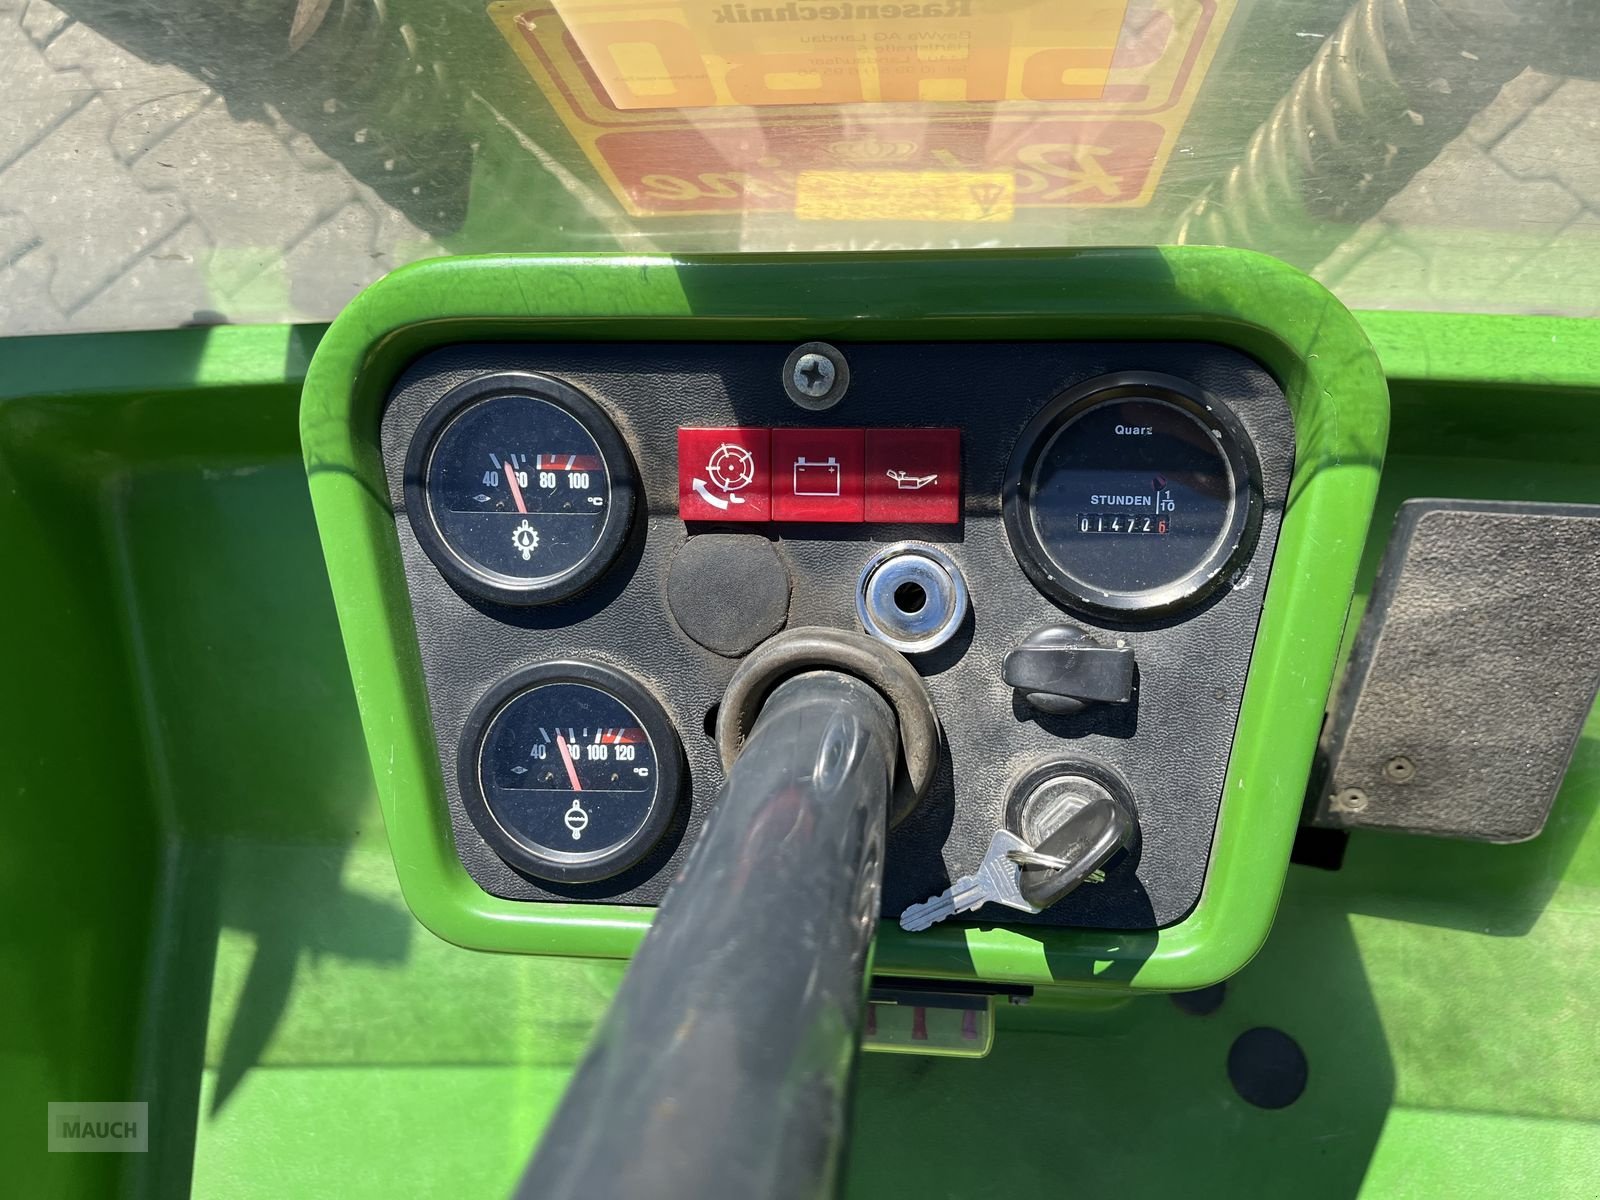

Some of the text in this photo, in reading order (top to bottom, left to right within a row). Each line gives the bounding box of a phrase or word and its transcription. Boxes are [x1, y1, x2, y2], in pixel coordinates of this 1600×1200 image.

[1114, 424, 1153, 436] Quarz
[482, 471, 499, 487] 40
[539, 472, 556, 488] 80
[567, 473, 590, 489] 100
[1090, 494, 1151, 506] STUNDEN
[530, 743, 547, 760] 40
[586, 744, 608, 761] 100
[614, 744, 635, 761] 120
